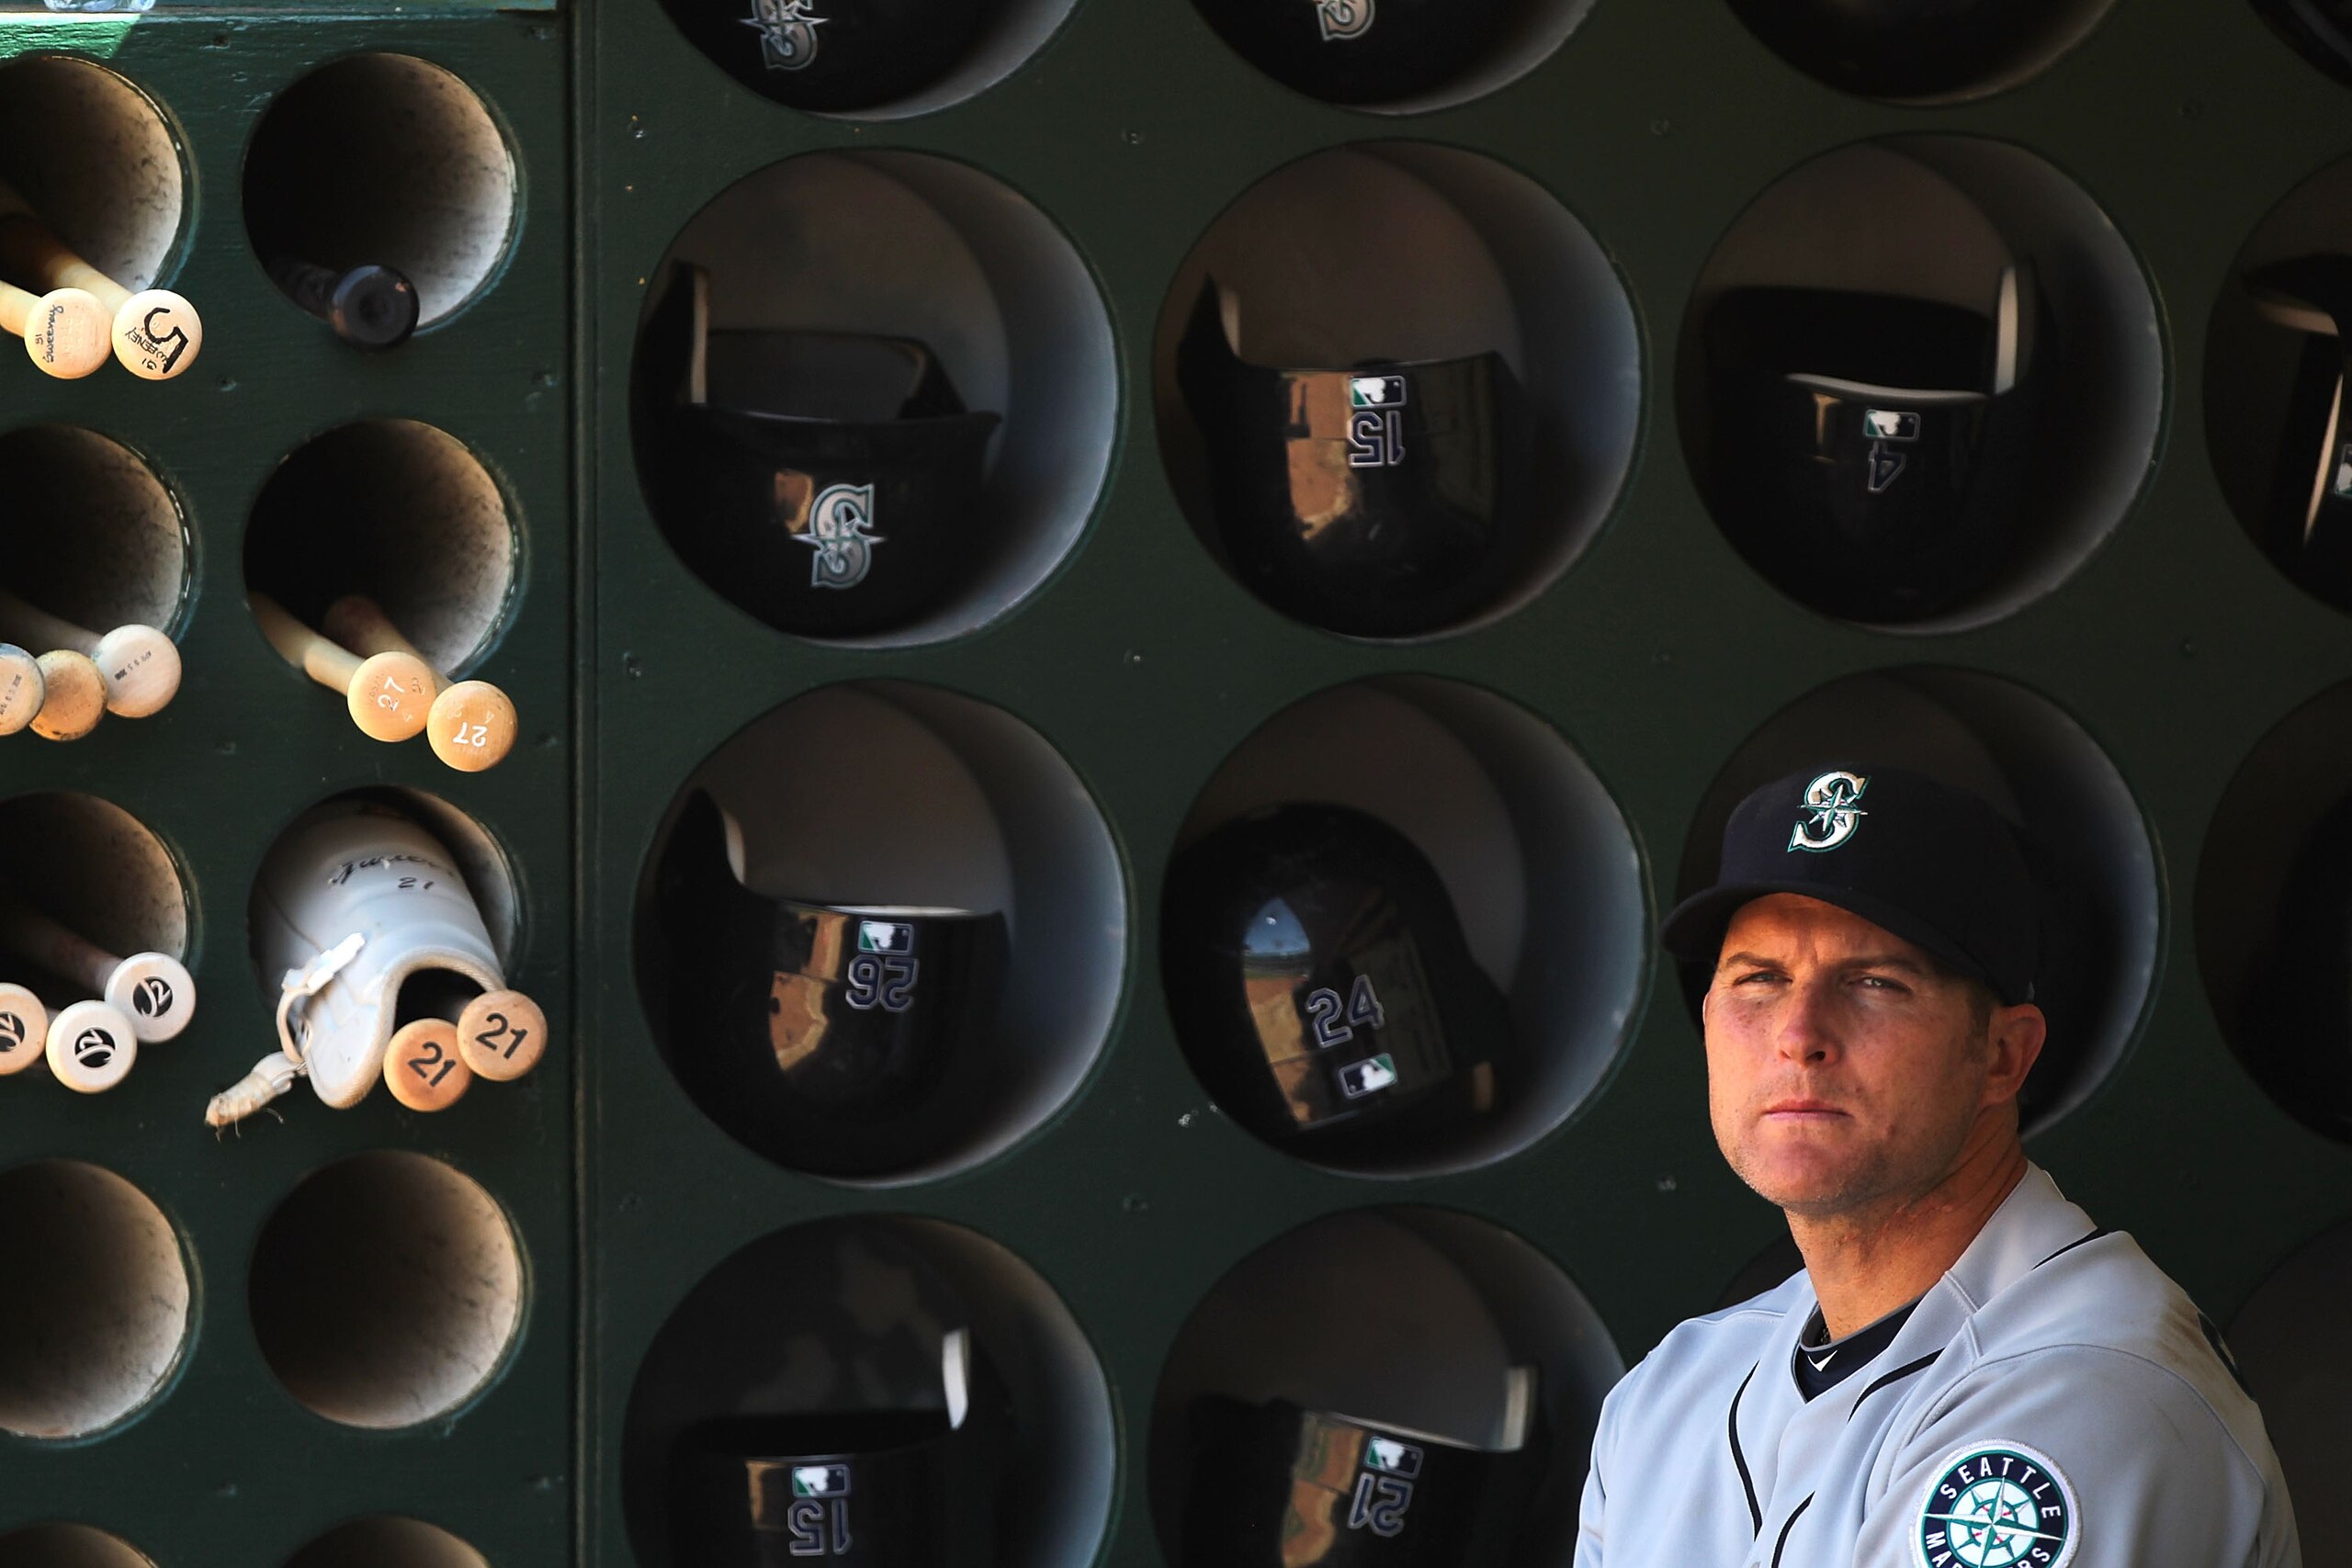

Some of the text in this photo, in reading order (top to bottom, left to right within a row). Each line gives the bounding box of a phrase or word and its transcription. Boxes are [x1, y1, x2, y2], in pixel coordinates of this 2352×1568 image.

[124, 327, 168, 365] WEENEY
[143, 307, 189, 375] 5
[1347, 410, 1406, 468] 15
[1867, 440, 1907, 494] 4
[809, 483, 875, 588] S
[377, 676, 405, 713] 27
[452, 722, 489, 747] 27
[1787, 771, 1871, 852] S
[398, 876, 435, 890] 21
[845, 953, 920, 1013] 26
[1305, 973, 1385, 1049] 24
[407, 1041, 457, 1088] 21
[475, 1012, 528, 1060] 21
[1345, 1472, 1414, 1538] 21
[1939, 1457, 2062, 1518] SEATTLE
[787, 1497, 853, 1556] 15
